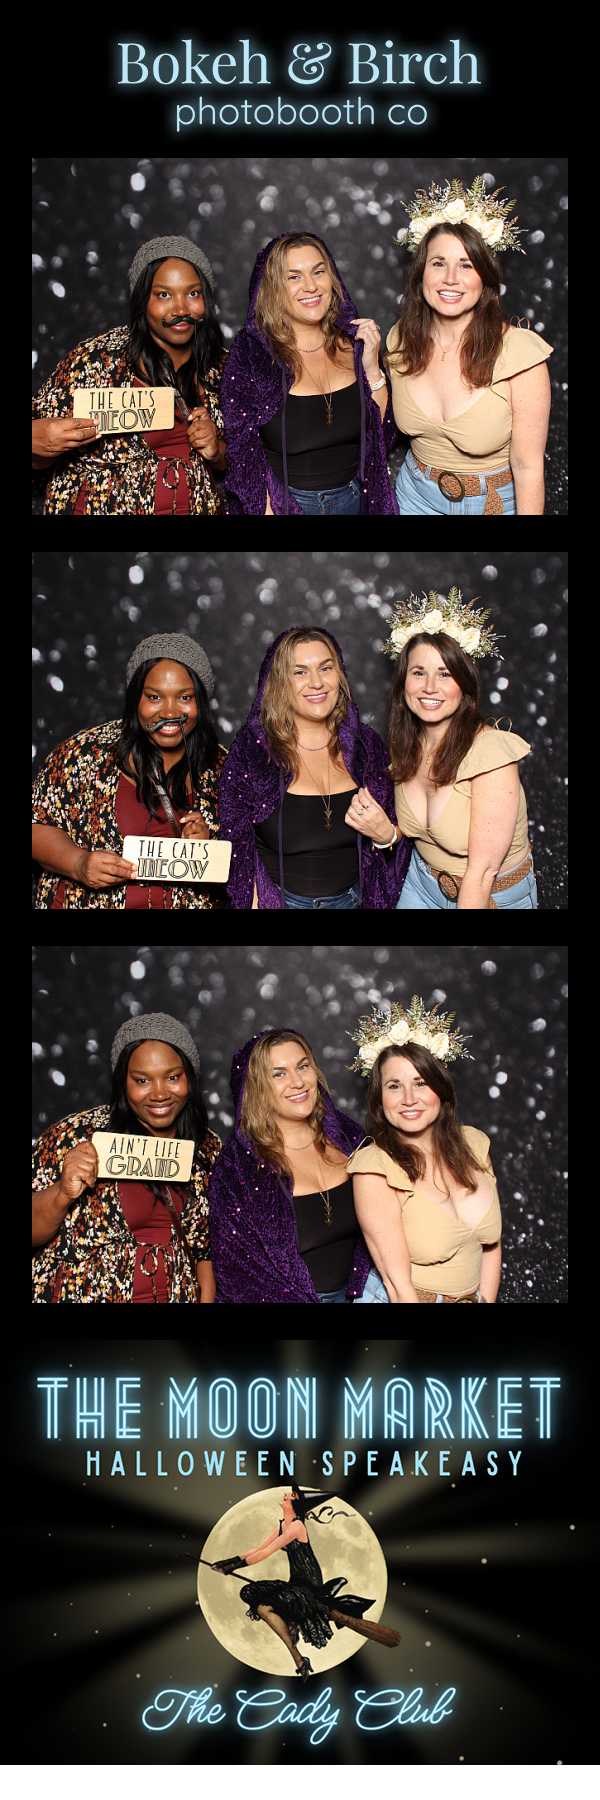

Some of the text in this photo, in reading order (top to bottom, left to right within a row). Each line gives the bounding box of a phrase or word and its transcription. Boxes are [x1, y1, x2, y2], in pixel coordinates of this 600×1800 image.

[89, 390, 155, 410] THE CAT'S
[139, 839, 209, 860] THE CAT'S
[137, 857, 209, 880] MEOW
[109, 1136, 181, 1159] AIN'T LIFE
[105, 1154, 180, 1179] GRAND
